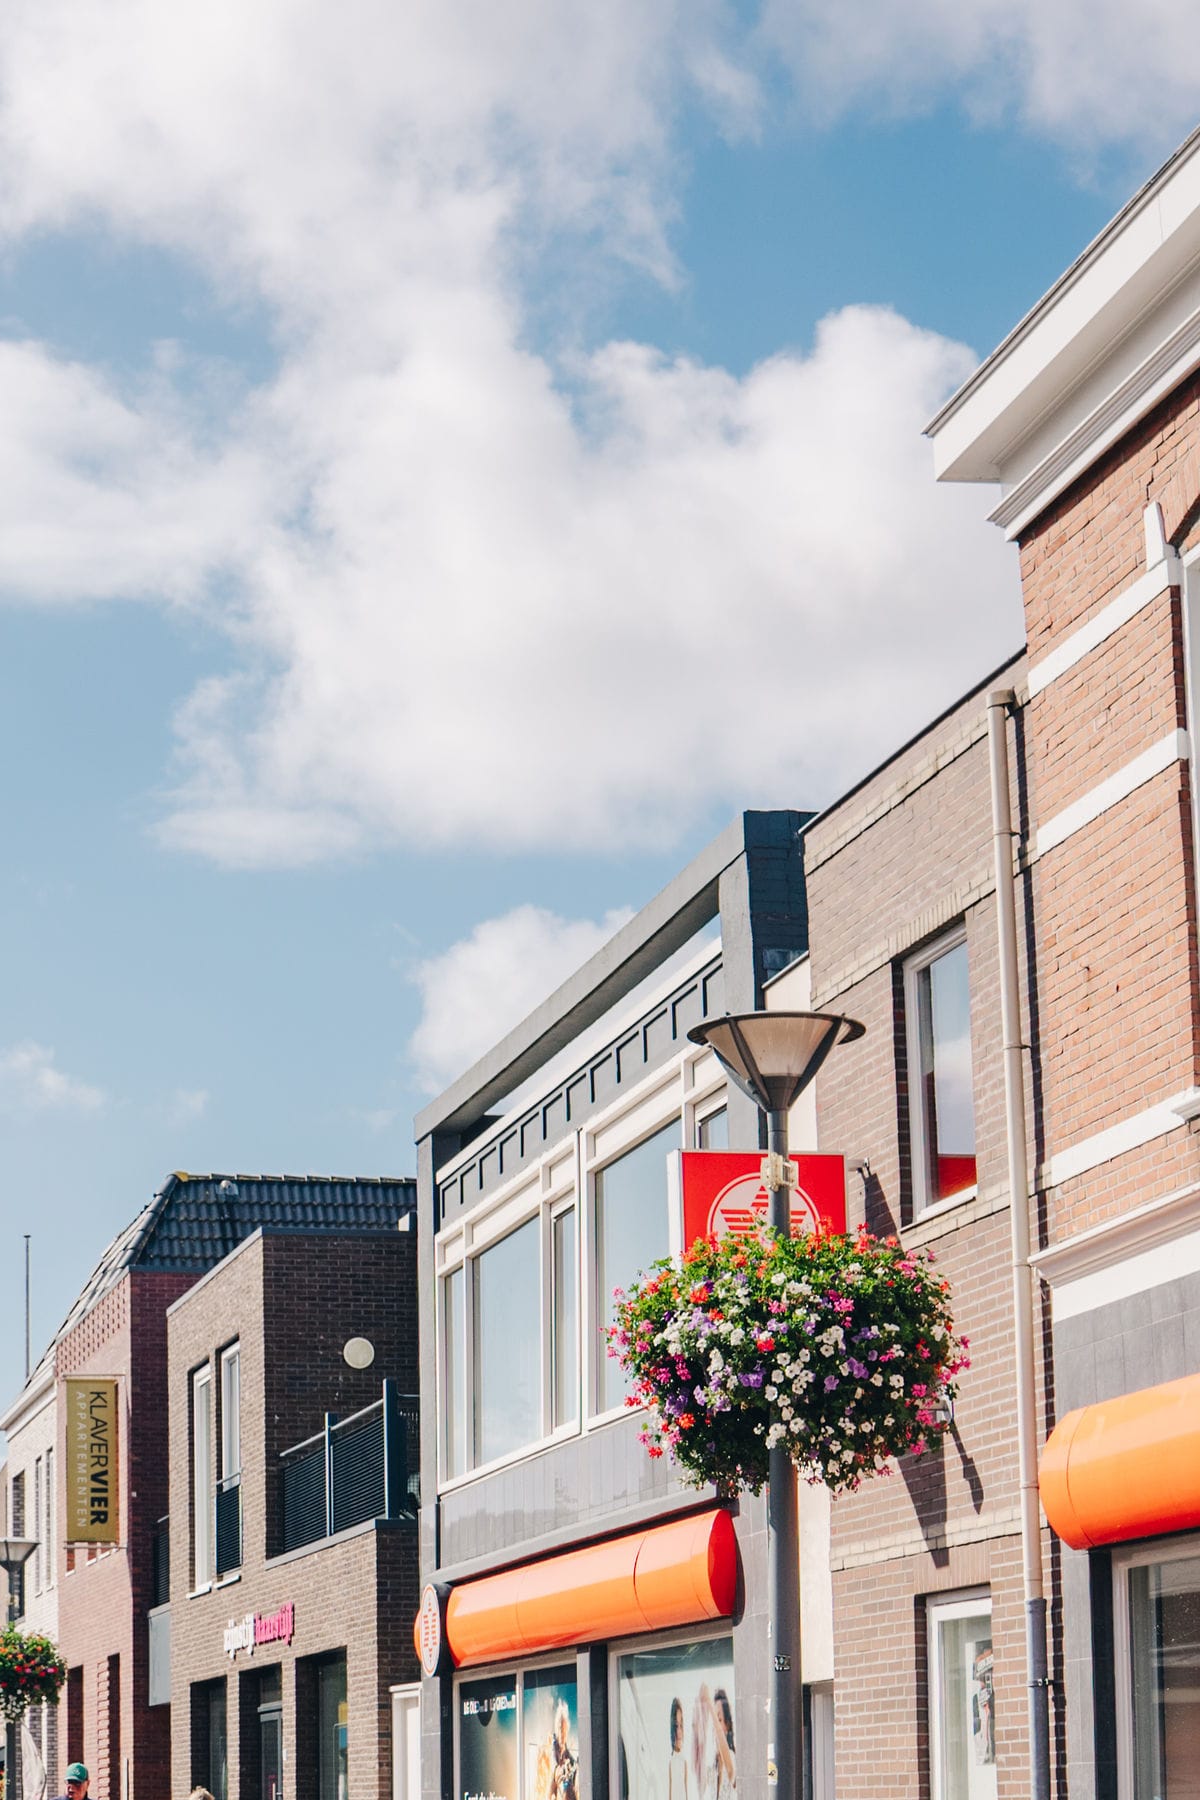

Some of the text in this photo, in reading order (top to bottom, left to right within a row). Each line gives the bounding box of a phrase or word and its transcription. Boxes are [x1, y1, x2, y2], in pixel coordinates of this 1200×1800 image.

[75, 1391, 88, 1527] APPARTEMENTEN
[89, 1391, 109, 1526] KLAVERVIER
[254, 1600, 293, 1646] haarstijl
